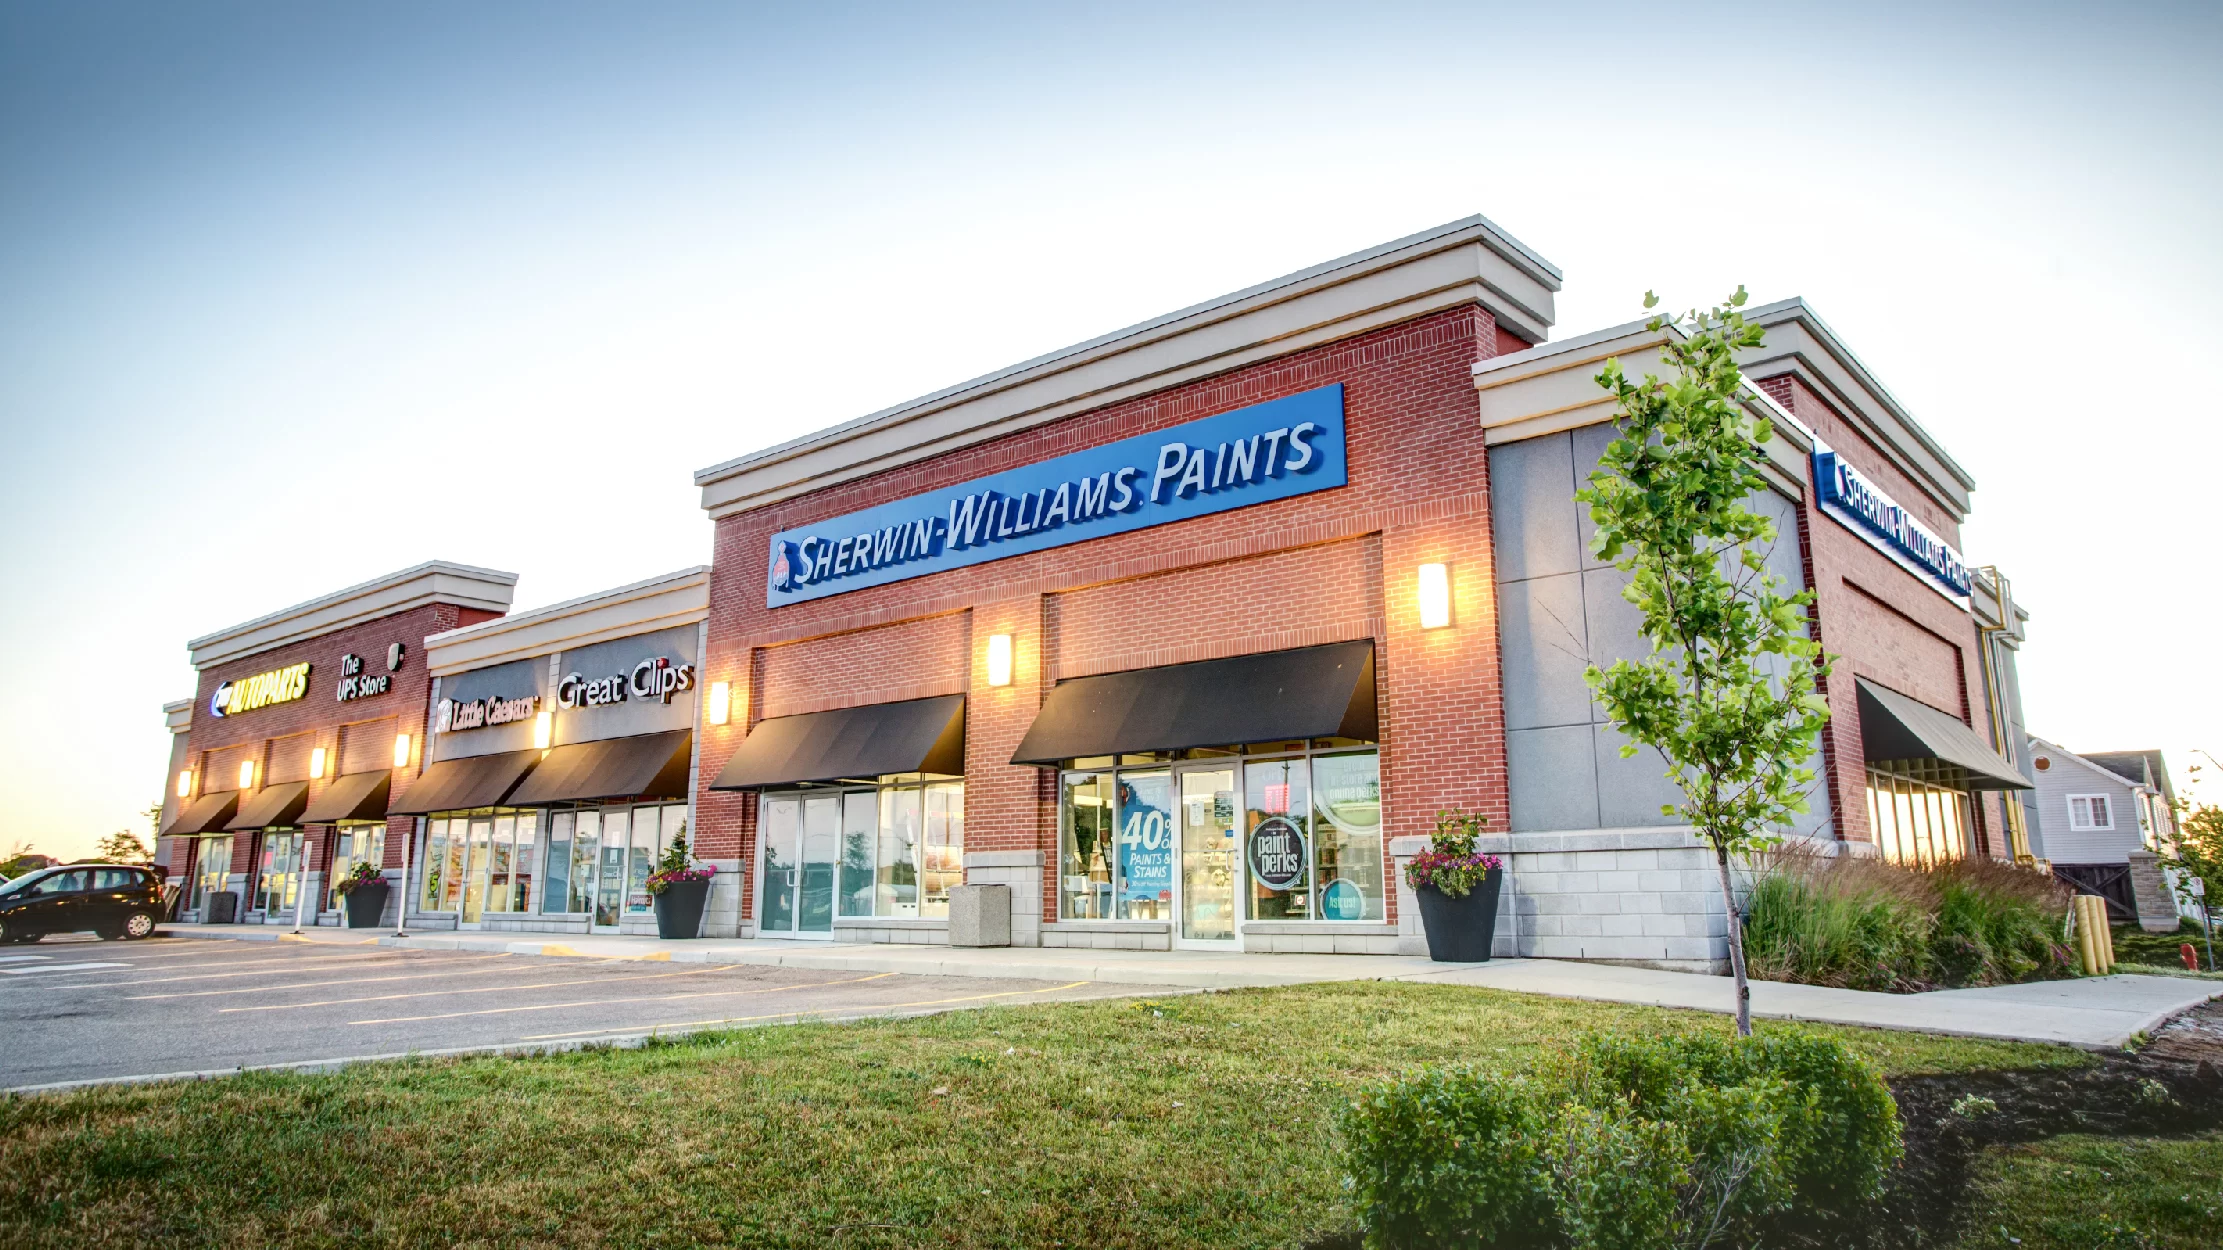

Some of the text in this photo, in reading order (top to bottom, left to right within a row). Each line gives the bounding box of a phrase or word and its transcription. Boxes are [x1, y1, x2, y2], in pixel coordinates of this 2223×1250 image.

[794, 422, 1315, 584] SHERWIN-WILLIAMS PAINTS
[341, 653, 360, 677] The
[337, 675, 388, 702] UPS Store
[557, 657, 691, 710] Great Clips
[451, 696, 534, 731] Little Caesars
[1329, 786, 1355, 800] online
[1257, 832, 1290, 857] paint
[1129, 853, 1162, 866] PAINTS
[1133, 865, 1167, 878] STAINS
[1262, 852, 1298, 877] perks
[1329, 896, 1356, 909] Ask us!
